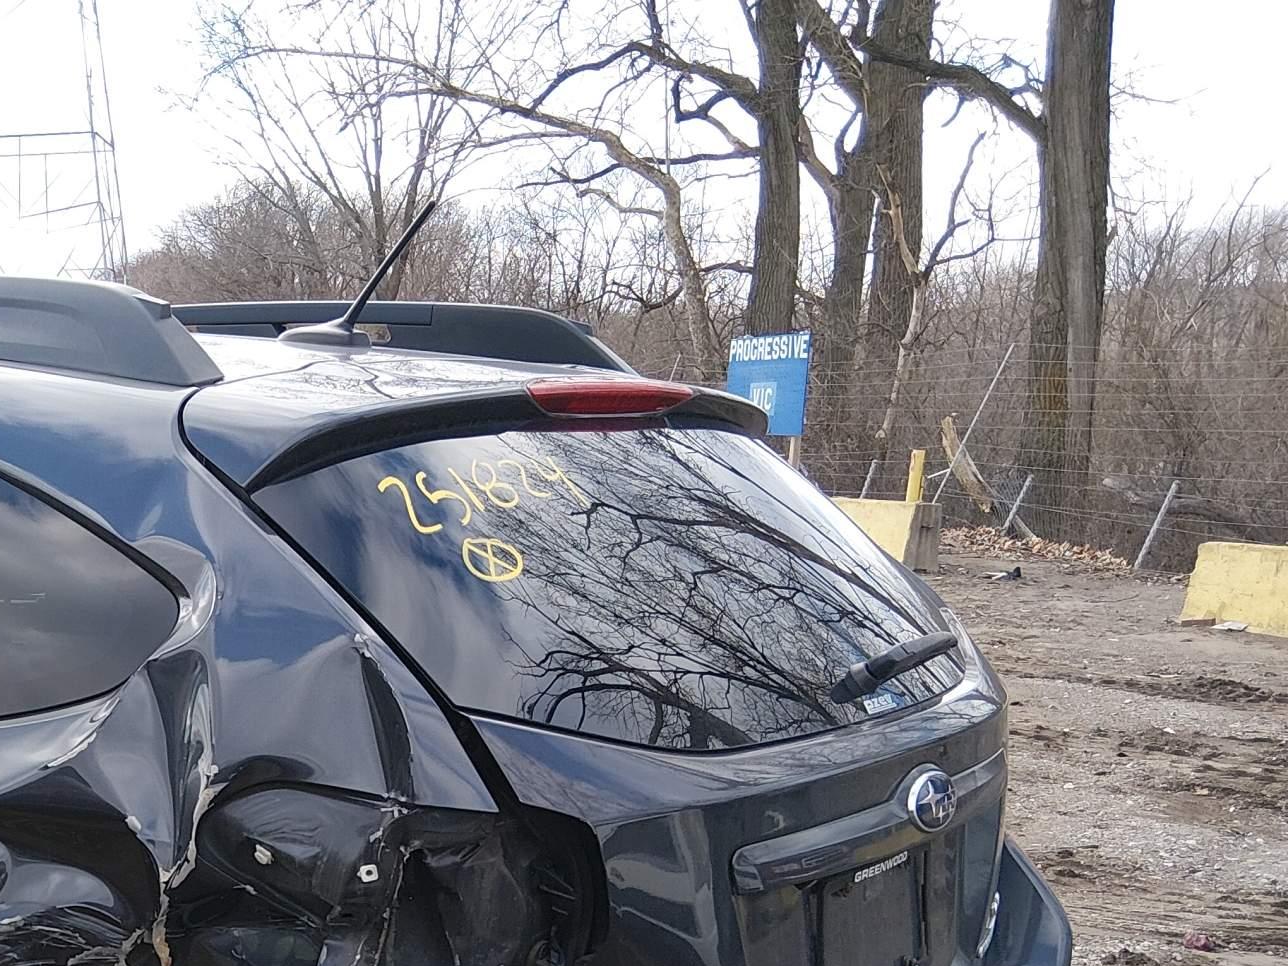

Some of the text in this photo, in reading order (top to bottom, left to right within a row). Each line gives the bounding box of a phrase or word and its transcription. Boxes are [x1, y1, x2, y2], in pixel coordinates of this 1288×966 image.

[728, 334, 810, 362] PROGRESSIVE
[376, 456, 592, 535] 251824
[853, 850, 909, 883] GREENWOOD
